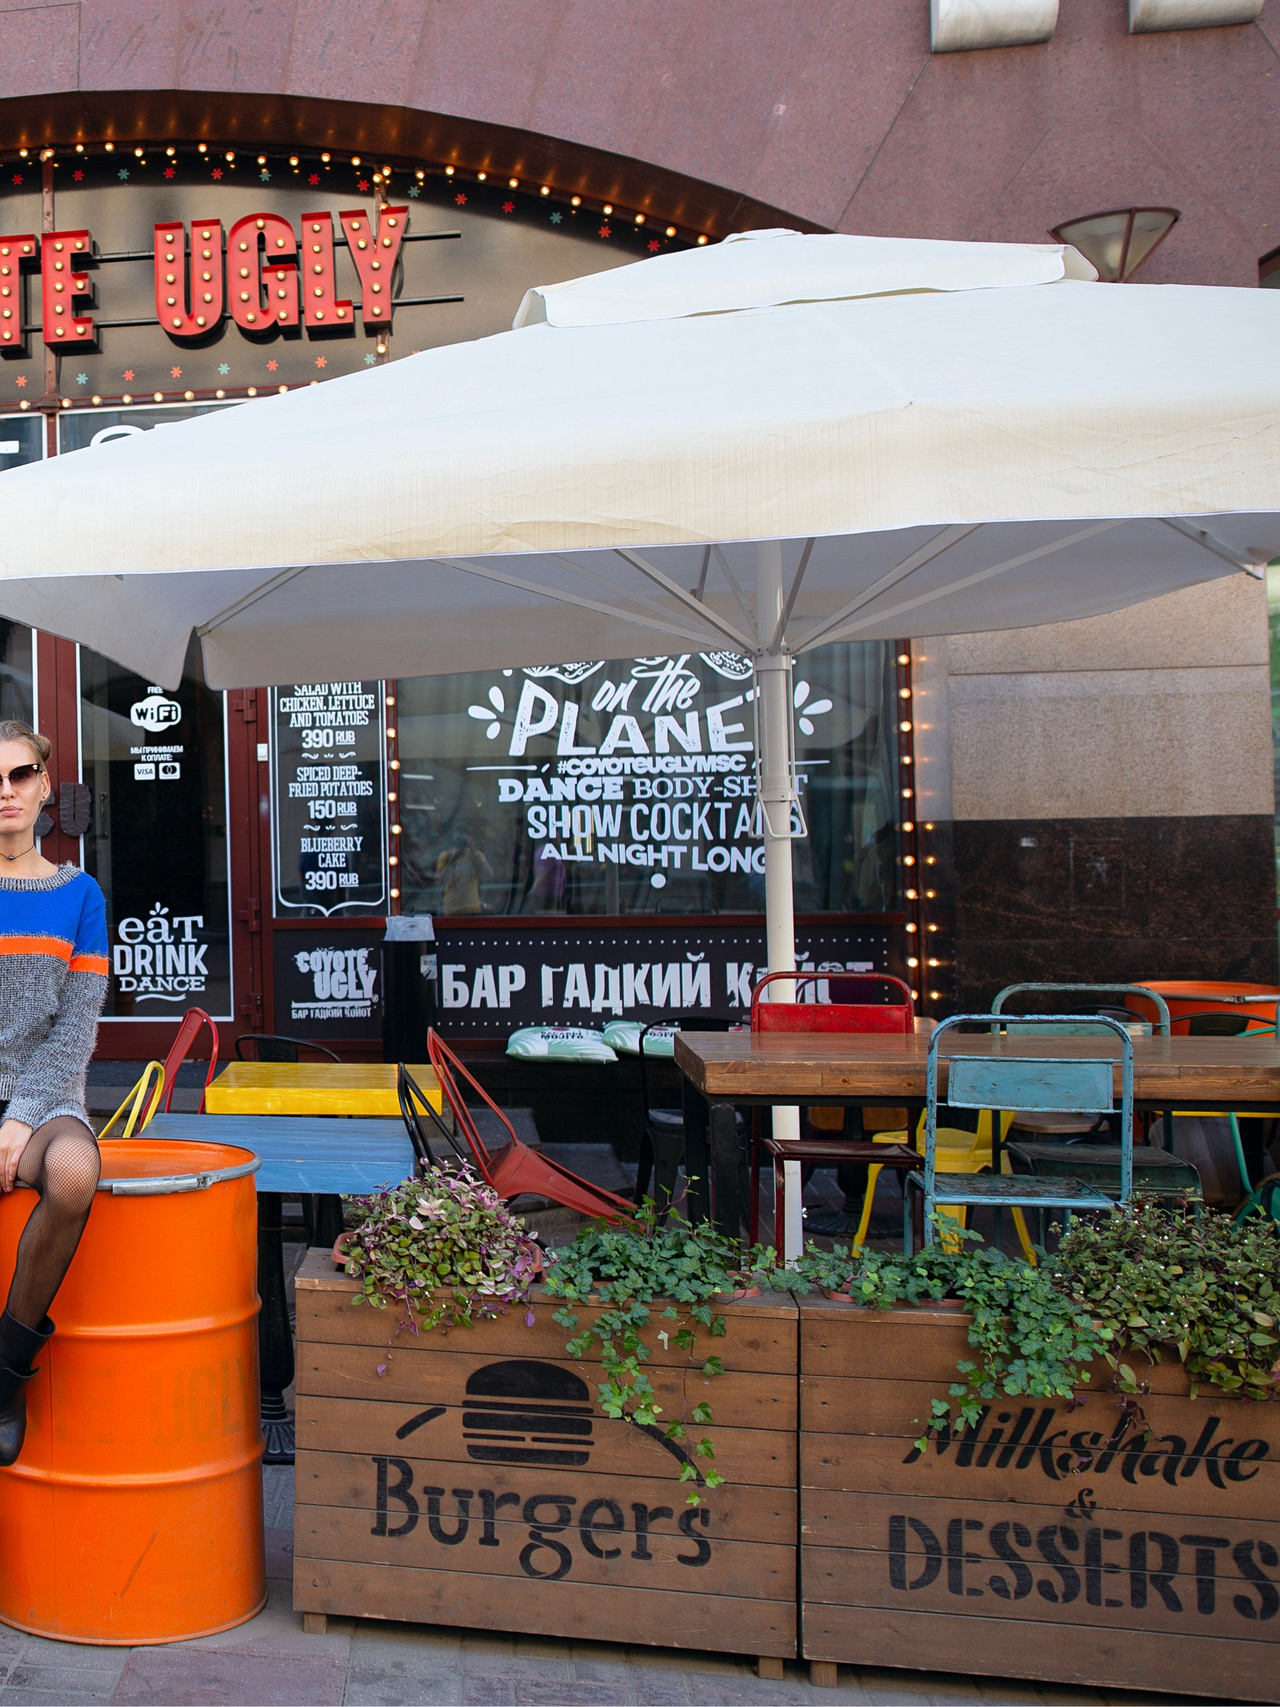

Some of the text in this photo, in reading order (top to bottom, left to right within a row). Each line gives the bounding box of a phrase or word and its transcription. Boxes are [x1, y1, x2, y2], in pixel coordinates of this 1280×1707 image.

[154, 206, 409, 340] UGLY
[294, 682, 362, 696] SALAD WITH
[592, 678, 638, 712] on
[631, 654, 701, 714] the
[328, 694, 375, 711] LETTUCE
[289, 710, 369, 728] AND TOMATOES
[509, 678, 760, 756] PLANE
[130, 745, 184, 754] МЫ ПРИНИМАЕМ
[302, 728, 356, 748] 390 RUB
[142, 754, 146, 762] К
[297, 765, 362, 782] SPICED DEEP-
[288, 781, 373, 798] FRIED POTATOES
[498, 774, 808, 802] DANCE BODY-SHT
[307, 800, 357, 820] 150 RUB
[527, 801, 806, 842] SHOW COCKTAIS
[300, 836, 364, 852] BLUEBERRY
[318, 852, 346, 868] CAKE
[540, 842, 766, 874] ALL NIGHT LONG
[305, 870, 359, 890] 390 RUB
[114, 944, 209, 975] DRINK
[294, 947, 370, 973] COYOTE
[119, 976, 206, 992] DANCE
[314, 969, 378, 1000] UGLY
[443, 963, 526, 1009] БАР
[541, 952, 712, 1016] ГАДКИЙ
[292, 1006, 372, 1020] БАР ГАДКИЙ КОЙОТ
[902, 1404, 1270, 1489] Milkshake
[1065, 1487, 1097, 1520] &
[371, 1456, 712, 1580] Burgers
[888, 1514, 1280, 1621] DESSERTS
